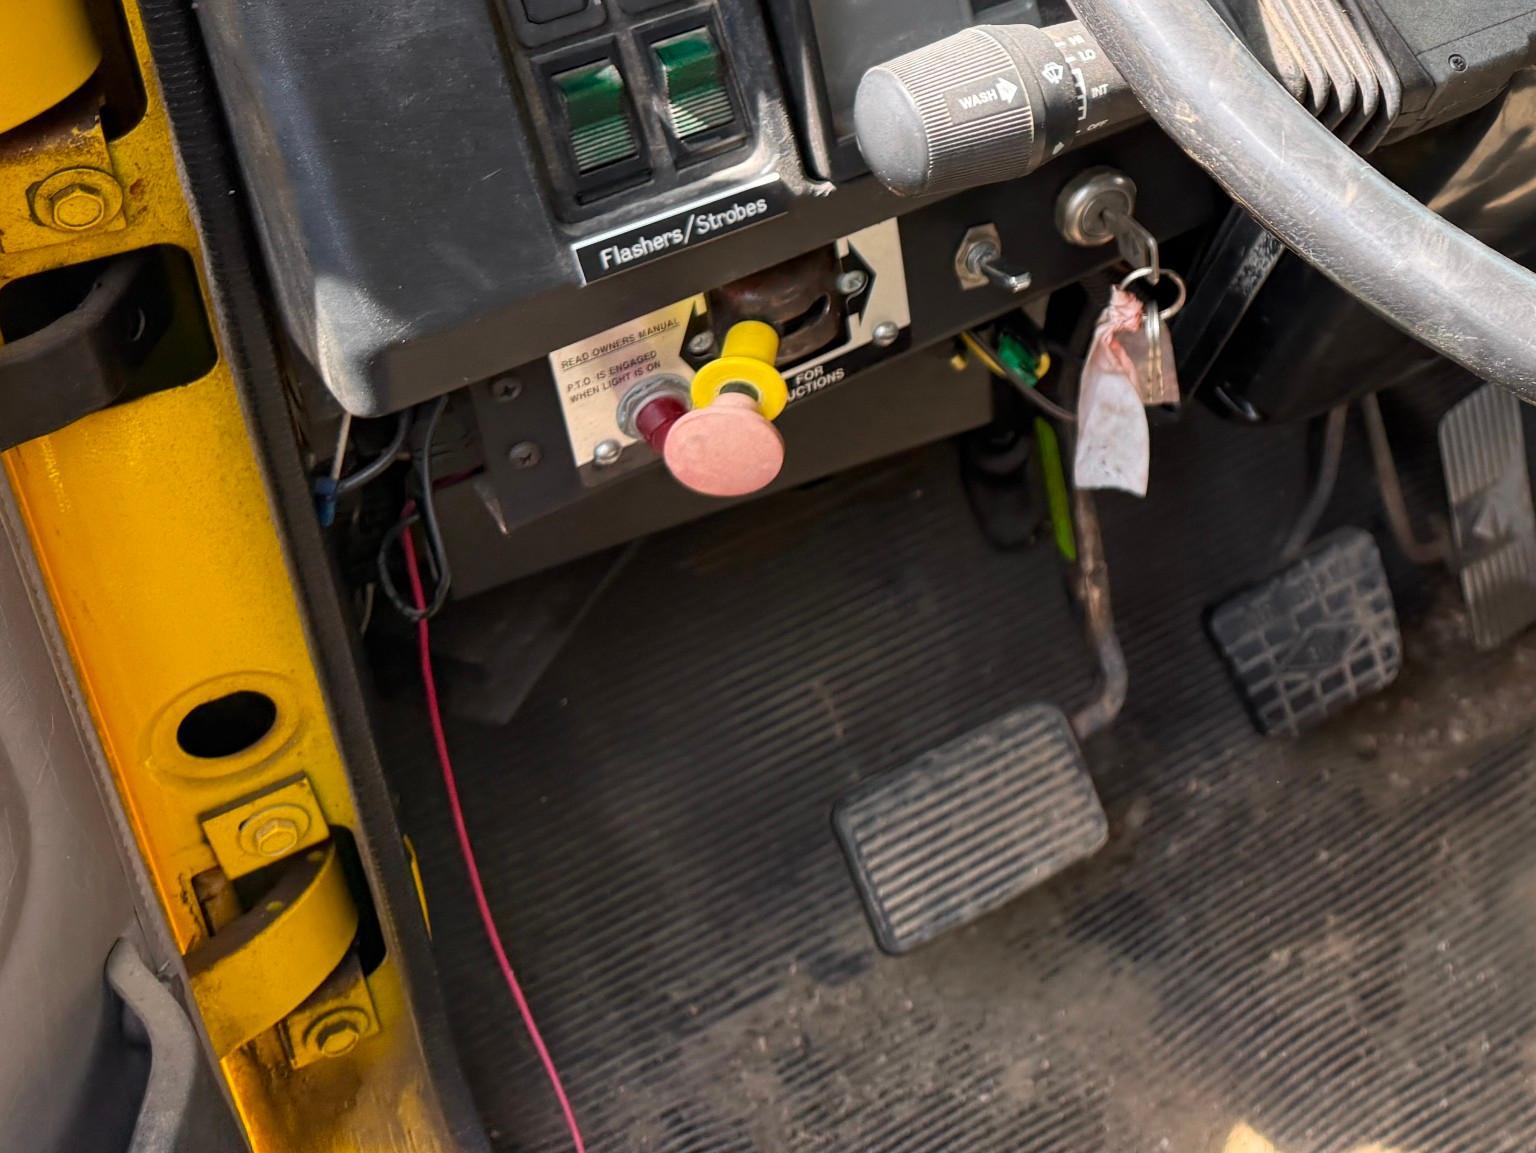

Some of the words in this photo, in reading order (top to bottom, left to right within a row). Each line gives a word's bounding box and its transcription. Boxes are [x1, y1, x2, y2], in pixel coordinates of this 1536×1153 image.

[1078, 49, 1097, 63] LO
[958, 89, 998, 110] WASH
[1092, 83, 1109, 99] INT
[599, 197, 768, 271] Flashers/Strobes
[561, 352, 589, 369] READ
[592, 334, 636, 357] OWNERS
[638, 318, 680, 339] MANUAL
[596, 370, 607, 381] IS
[608, 350, 657, 377] ENGAGED
[795, 365, 824, 385] FOR
[570, 386, 600, 403] WHEN
[602, 372, 630, 391] LIGHT
[634, 366, 645, 377] IS
[646, 360, 661, 373] ON
[788, 367, 845, 402] UCTIONS
